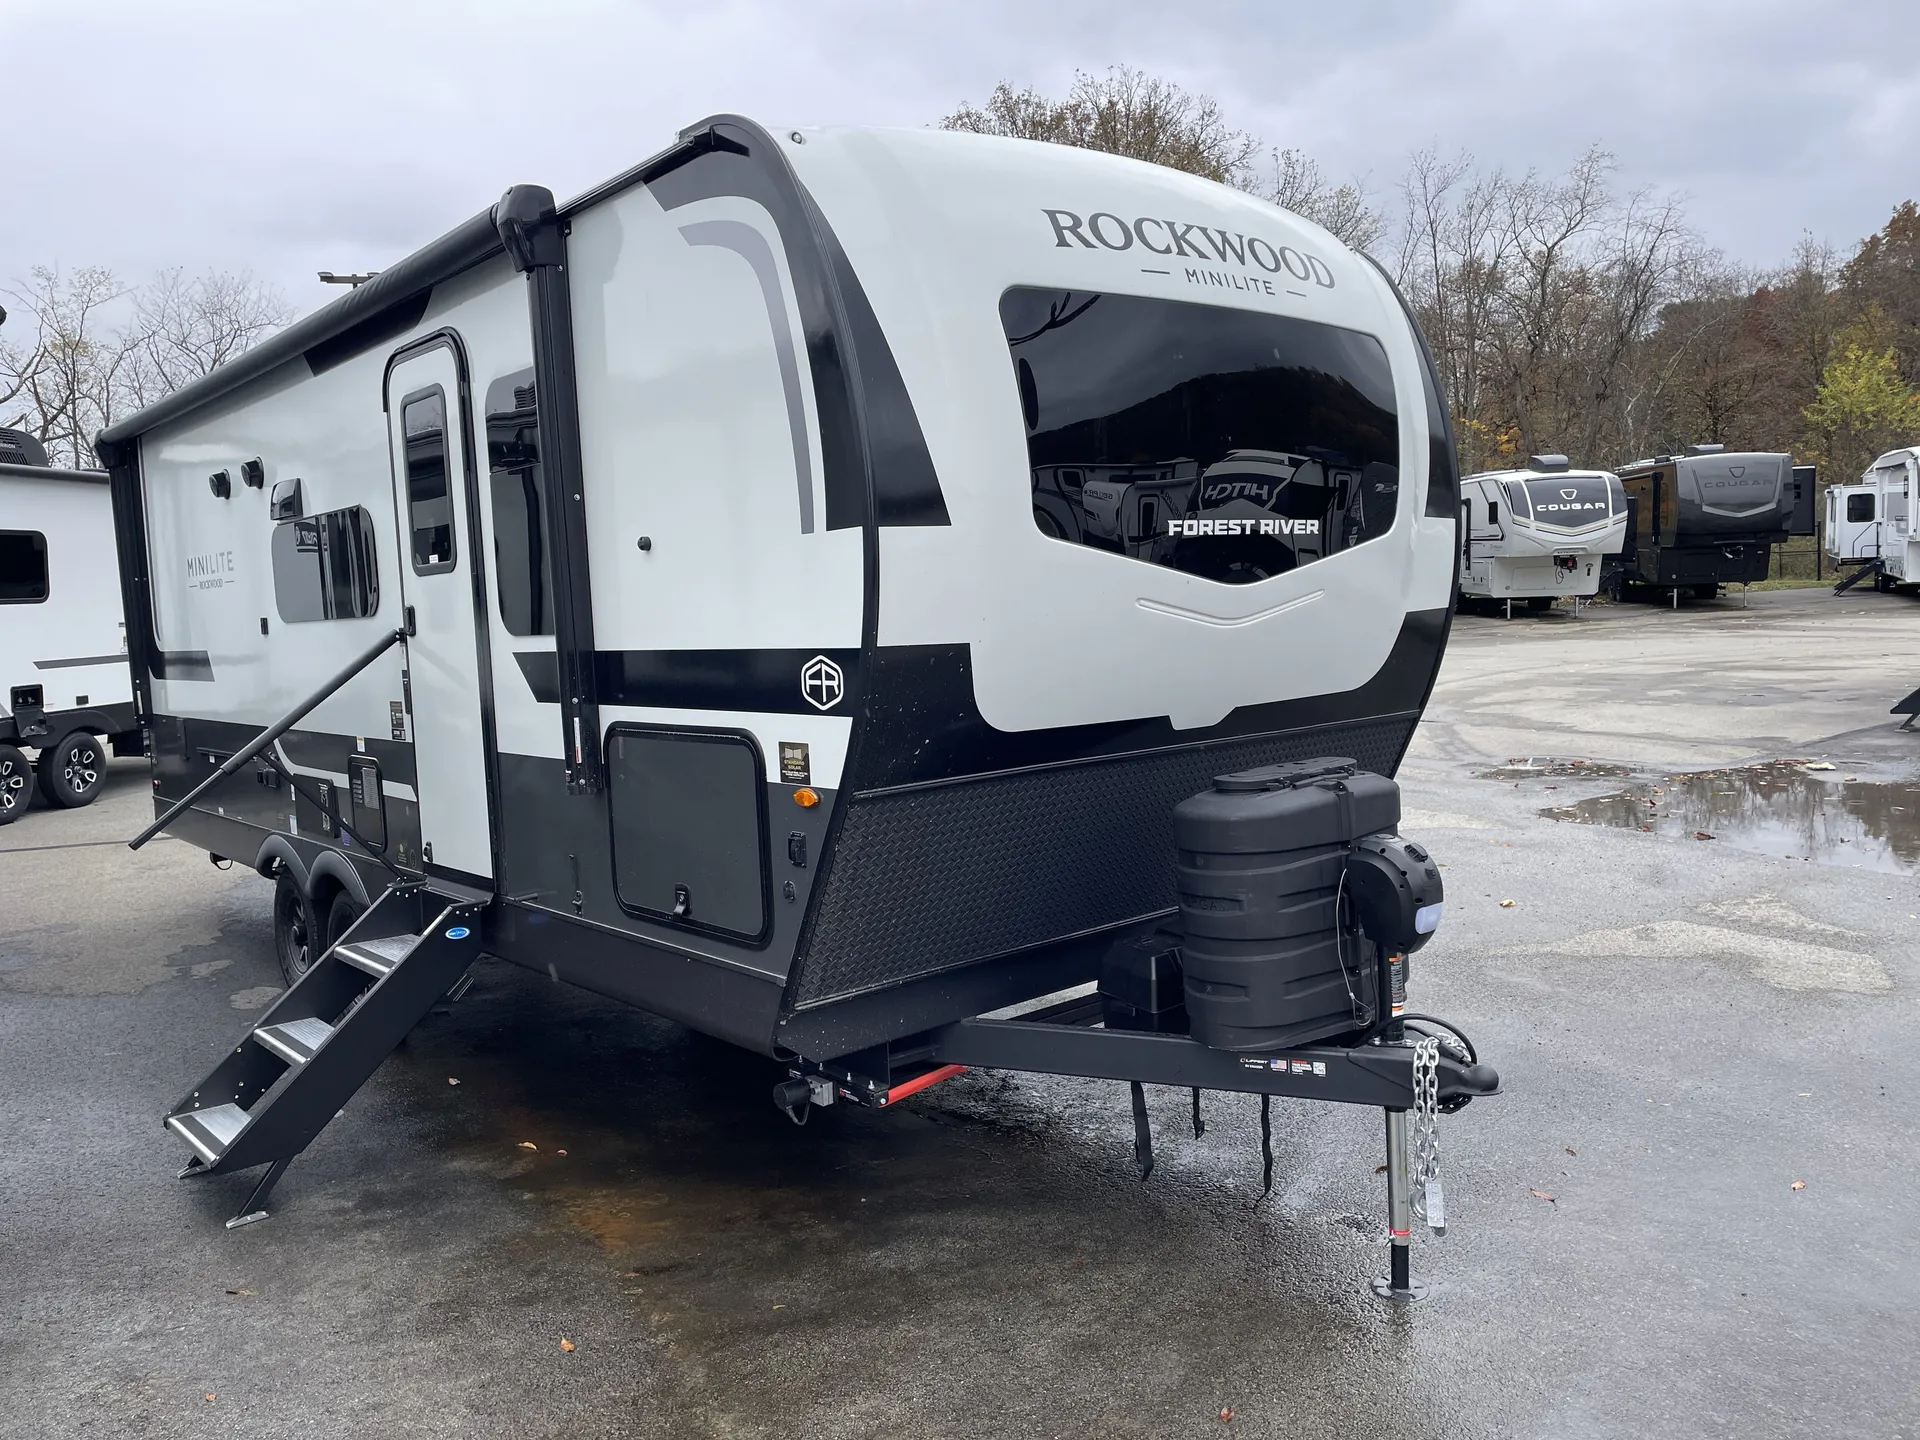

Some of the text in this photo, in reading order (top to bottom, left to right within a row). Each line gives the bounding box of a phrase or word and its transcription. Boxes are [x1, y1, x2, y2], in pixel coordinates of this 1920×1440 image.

[1041, 208, 1336, 289] ROCKWOOD
[1185, 267, 1276, 296] MINILITE
[1704, 479, 1774, 489] COUGAR
[1536, 502, 1606, 512] COUGAR
[1167, 519, 1319, 536] FOREST RIVER
[187, 551, 234, 578] MINILITE
